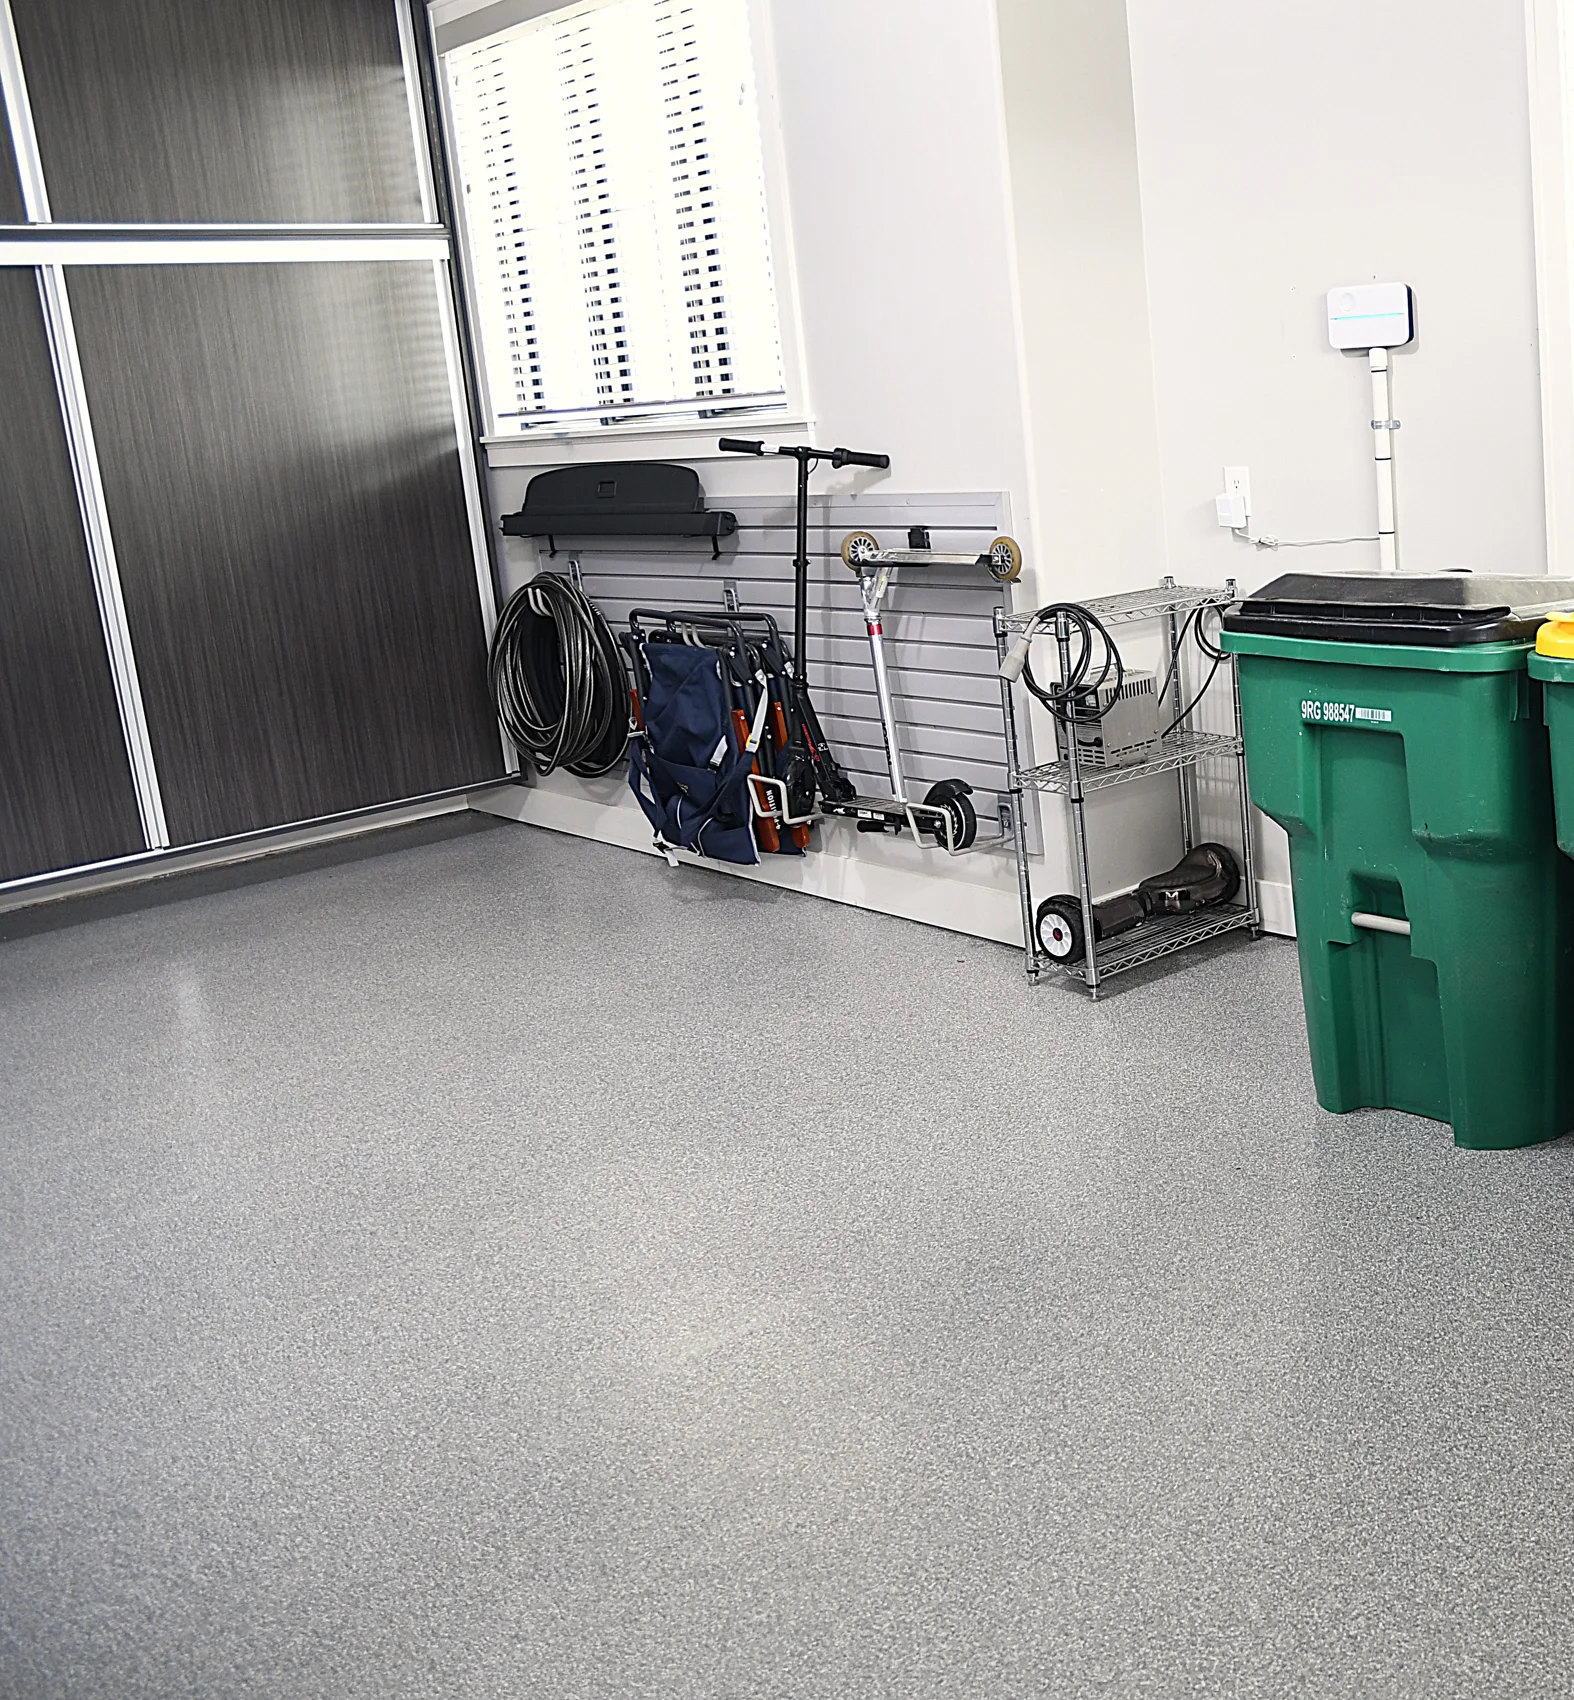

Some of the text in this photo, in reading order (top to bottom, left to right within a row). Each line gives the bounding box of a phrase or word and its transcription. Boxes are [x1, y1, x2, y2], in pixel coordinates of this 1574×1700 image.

[1301, 700, 1355, 722] 9RG 988547
[766, 789, 781, 830] 4-PITION
